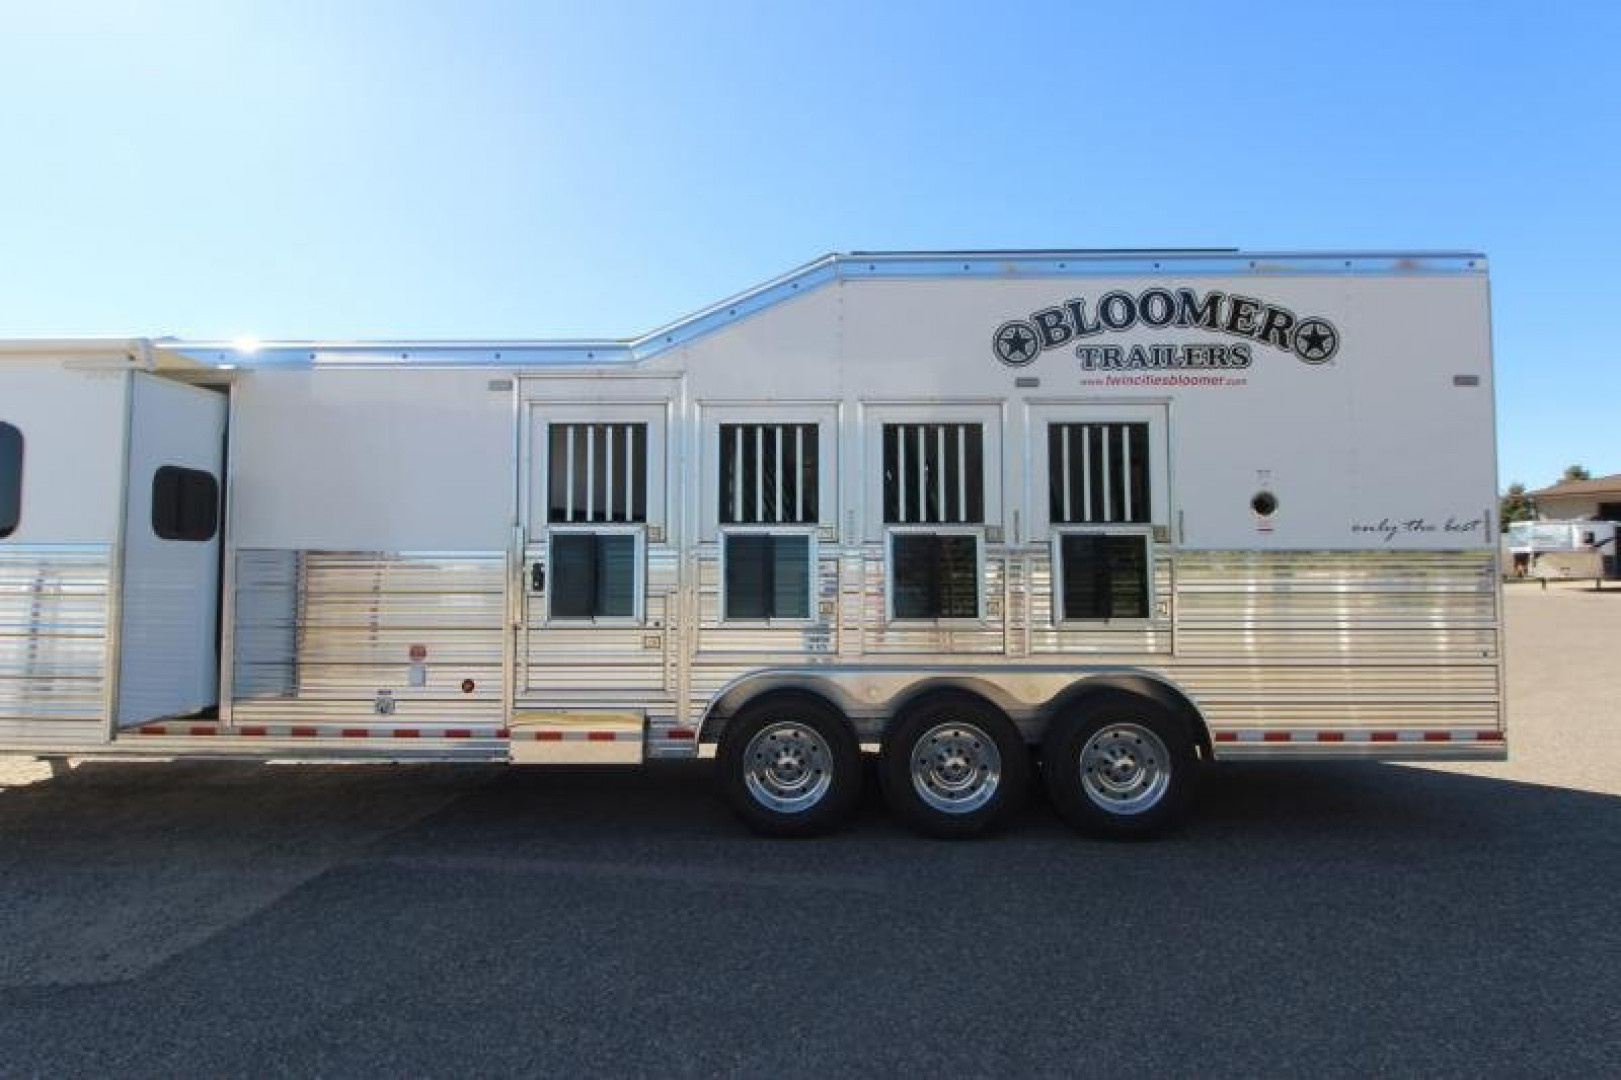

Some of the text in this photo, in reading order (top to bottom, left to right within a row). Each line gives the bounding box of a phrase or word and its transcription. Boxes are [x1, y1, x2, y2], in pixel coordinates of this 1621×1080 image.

[1030, 287, 1298, 352] BLOOMER
[1076, 344, 1252, 370] TRAILERS
[1080, 374, 1248, 387] www.twincitiesbloomer.com
[1351, 516, 1482, 542] only the best
